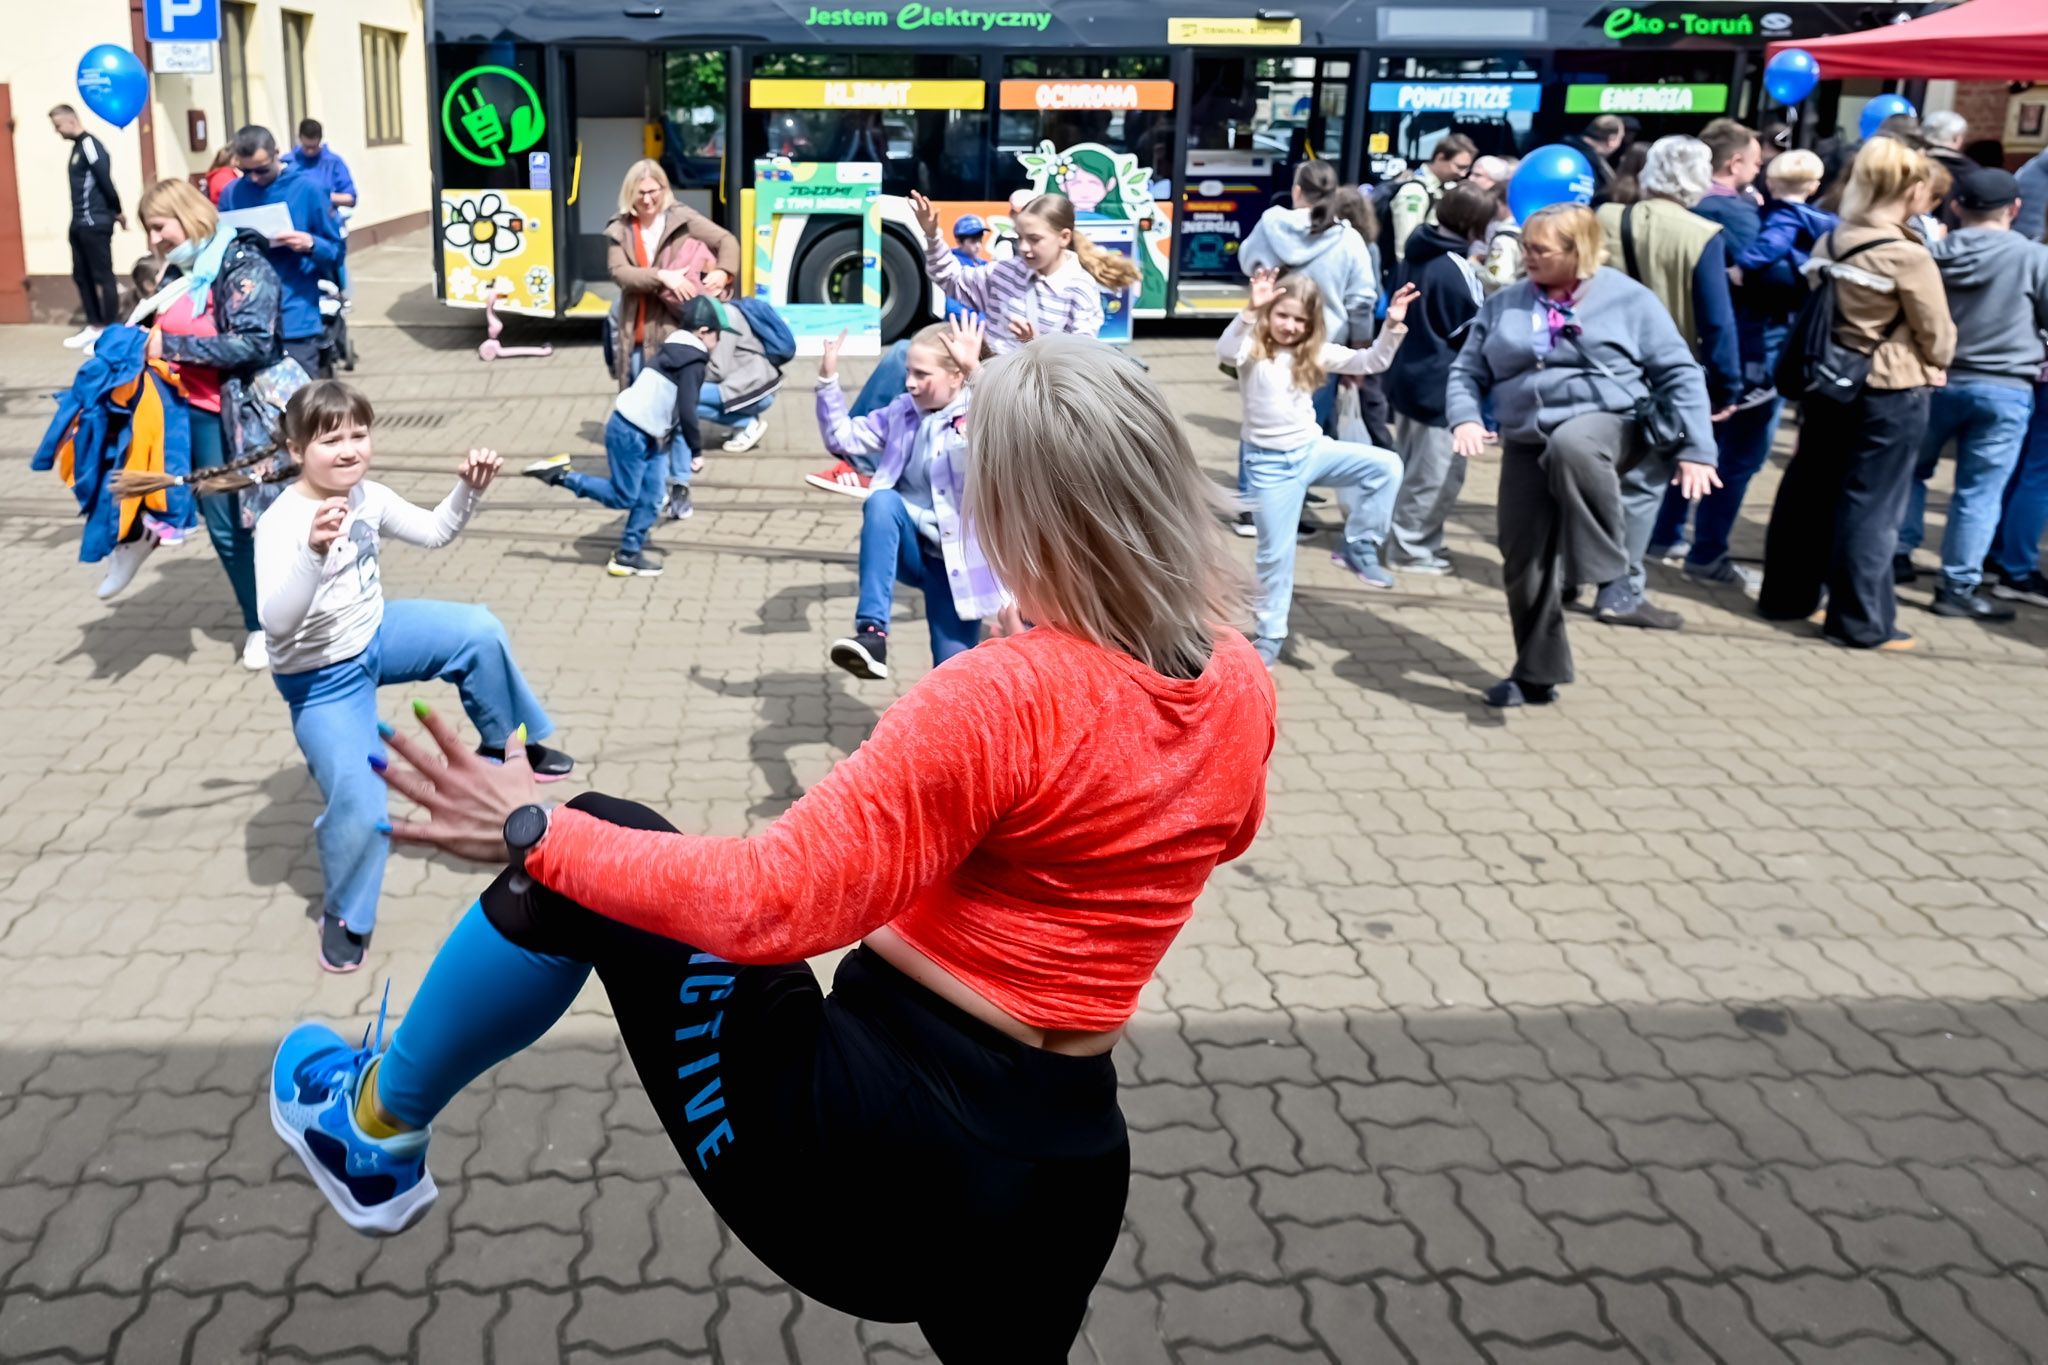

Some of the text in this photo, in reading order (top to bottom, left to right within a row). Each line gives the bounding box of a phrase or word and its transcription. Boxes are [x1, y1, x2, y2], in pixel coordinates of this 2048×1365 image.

[160, 0, 202, 33] P
[806, 6, 889, 27] Jestem
[1680, 13, 1754, 36] Toruń
[823, 81, 912, 107] KLIMAT
[1035, 83, 1138, 109] OCHRONA
[1397, 84, 1514, 110] POWIETRZE
[1599, 86, 1693, 112] ENERGIA
